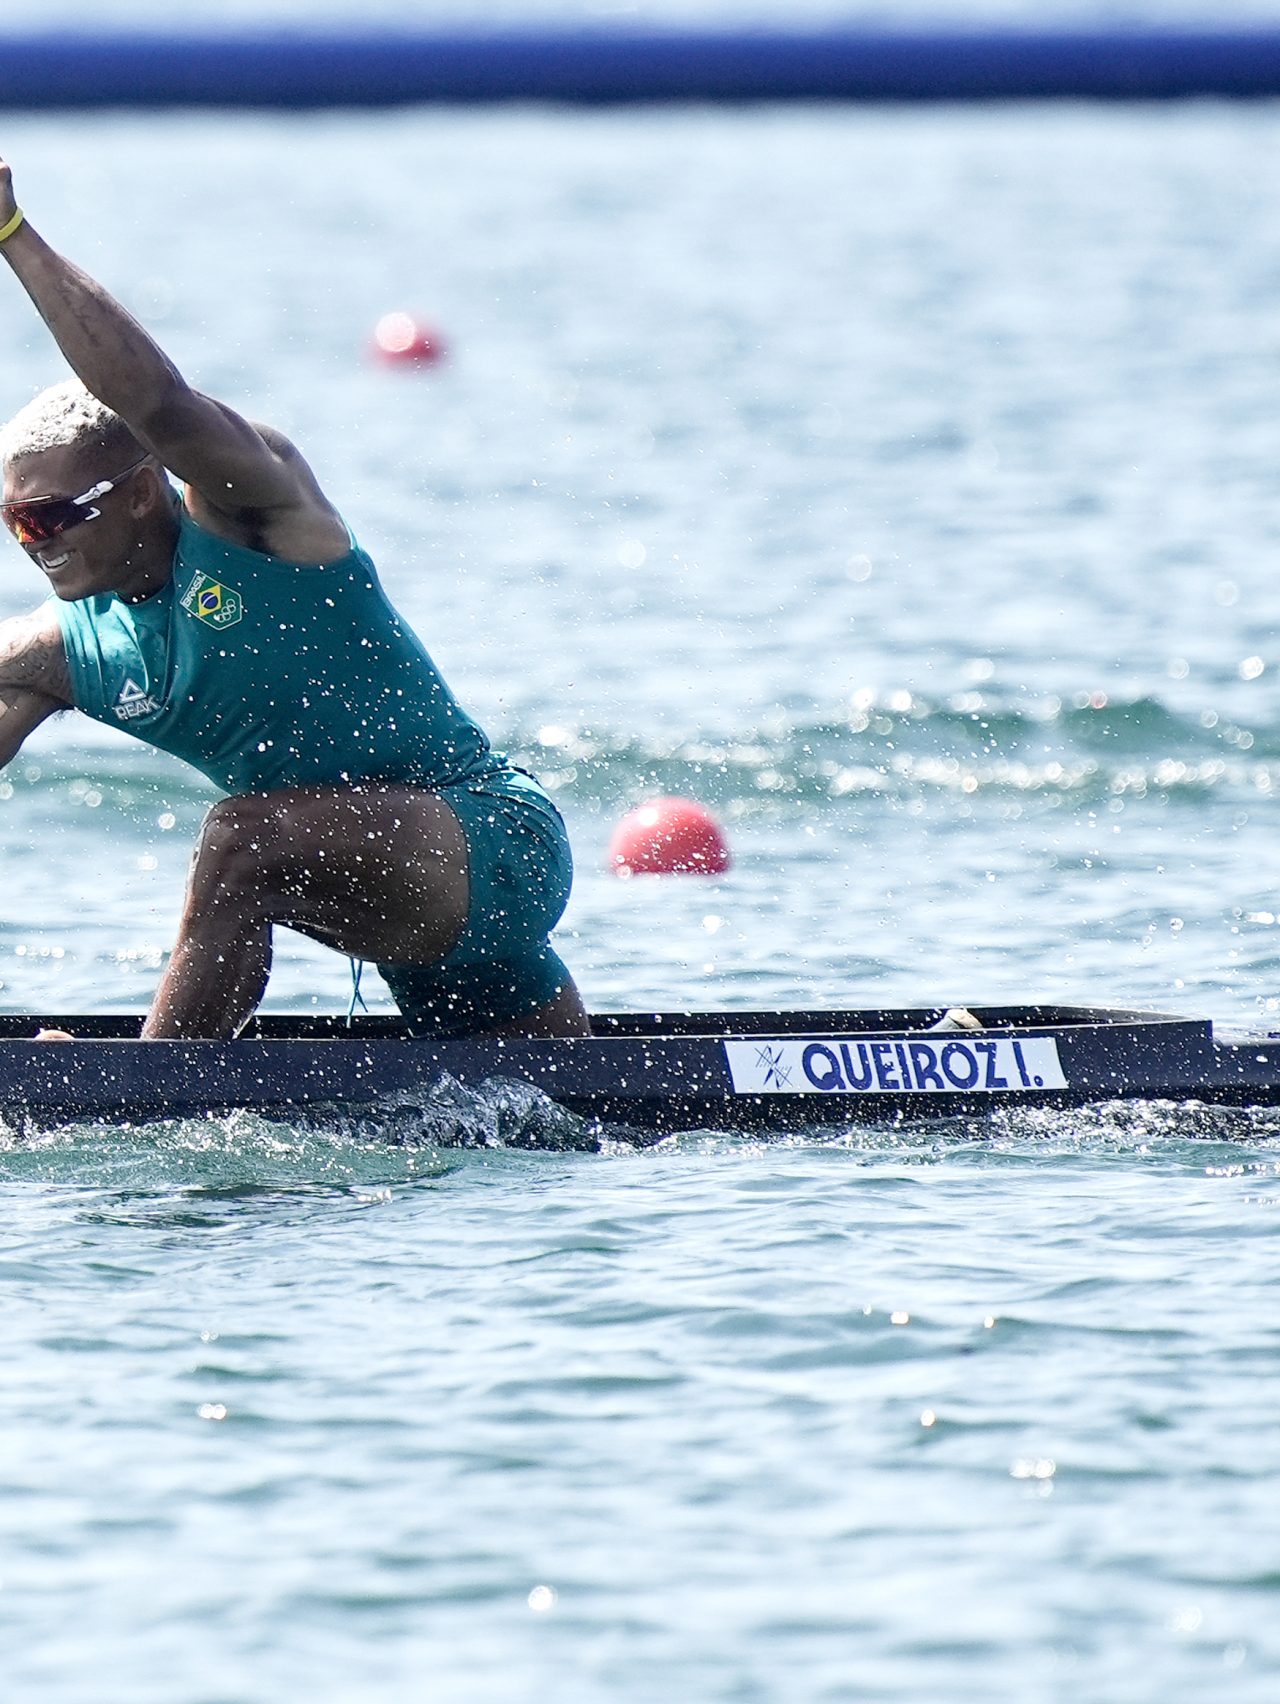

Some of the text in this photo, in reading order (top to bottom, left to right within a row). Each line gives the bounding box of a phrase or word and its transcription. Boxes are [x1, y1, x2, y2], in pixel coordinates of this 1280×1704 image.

[183, 575, 206, 608] BRASIL
[114, 694, 161, 720] PEAK
[801, 1040, 1044, 1091] QUEIROZ I.
